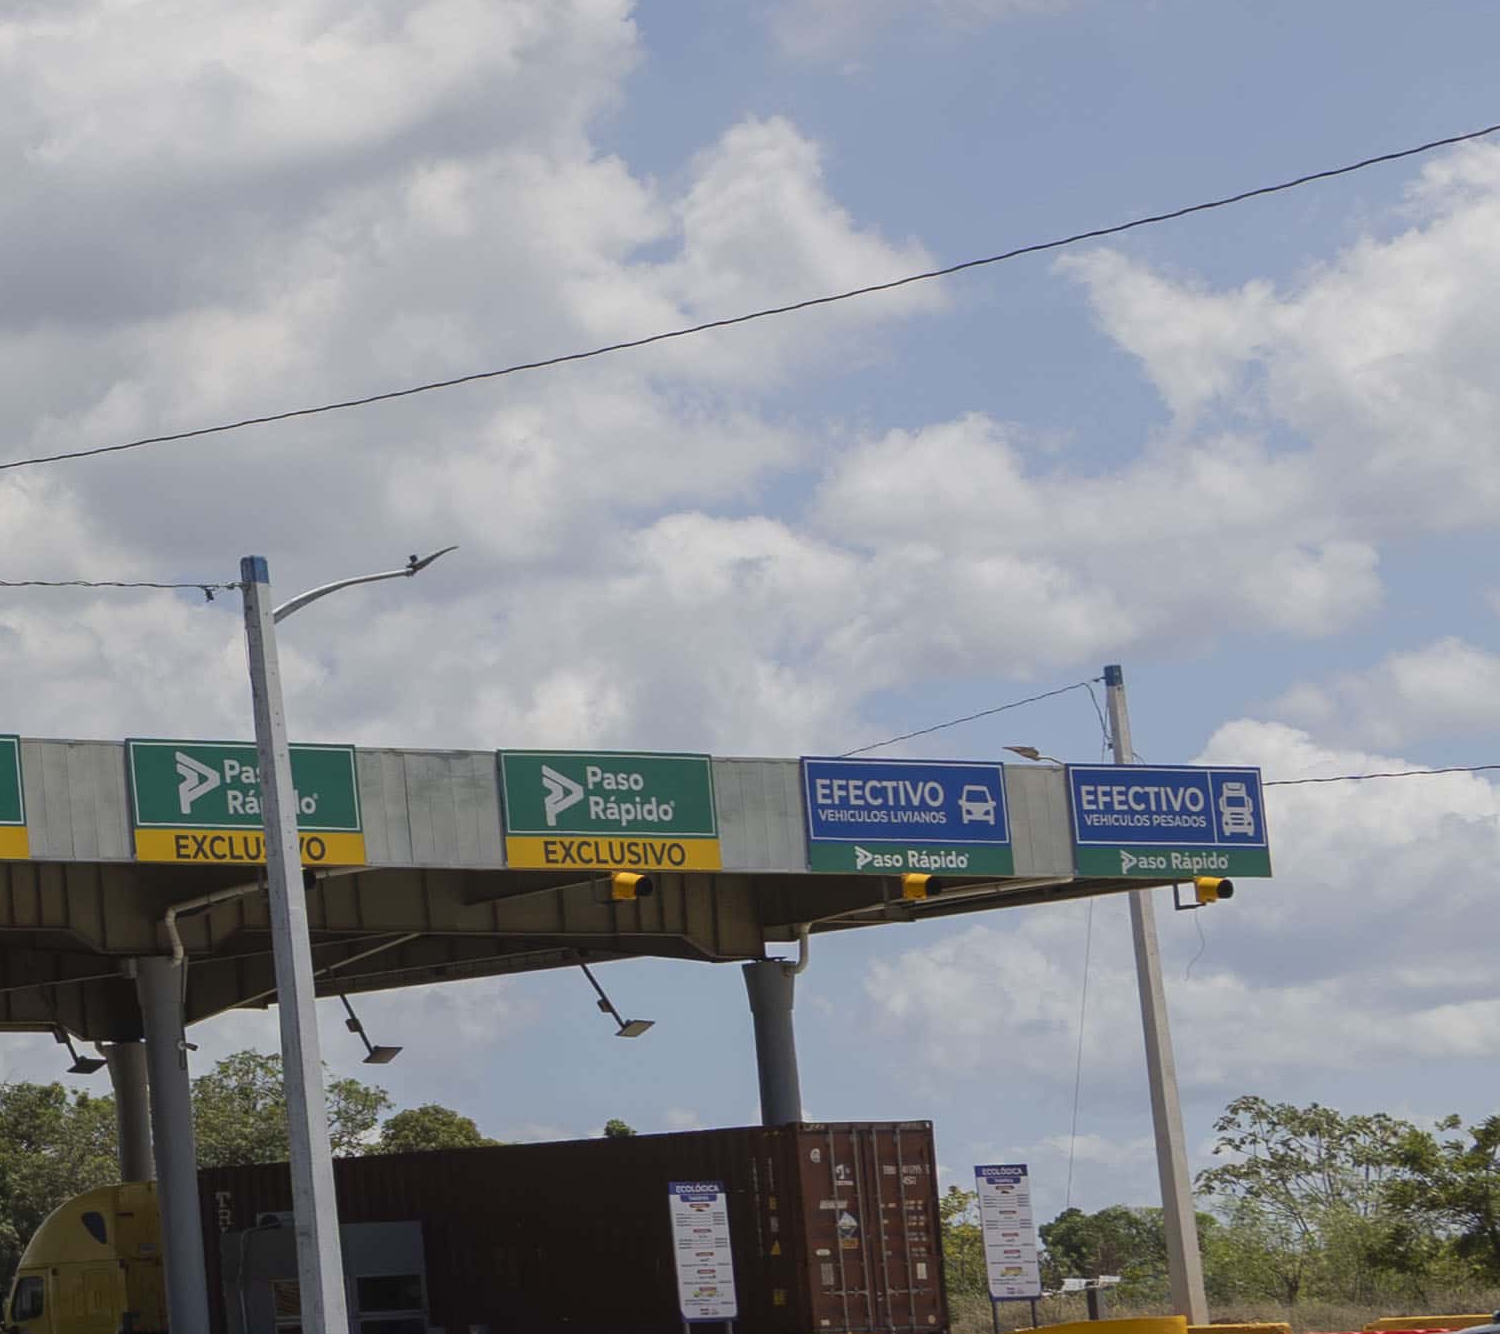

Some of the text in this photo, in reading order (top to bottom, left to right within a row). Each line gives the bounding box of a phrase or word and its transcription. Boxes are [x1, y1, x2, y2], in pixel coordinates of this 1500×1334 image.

[223, 759, 262, 785] Pa
[586, 766, 644, 791] Paso
[227, 789, 317, 815] Ráo
[815, 778, 945, 807] EFECTIVO
[1080, 785, 1205, 812] EFECTIVO
[589, 795, 675, 827] Rápido
[818, 809, 948, 824] VEHICULOS LIVIANOS
[1083, 813, 1207, 828] VEHICULOS PESADOS
[174, 834, 326, 861] EXCLUO
[542, 840, 686, 867] EXCLUSIVO
[907, 849, 969, 870] Rápido
[1171, 851, 1229, 874] Rápido
